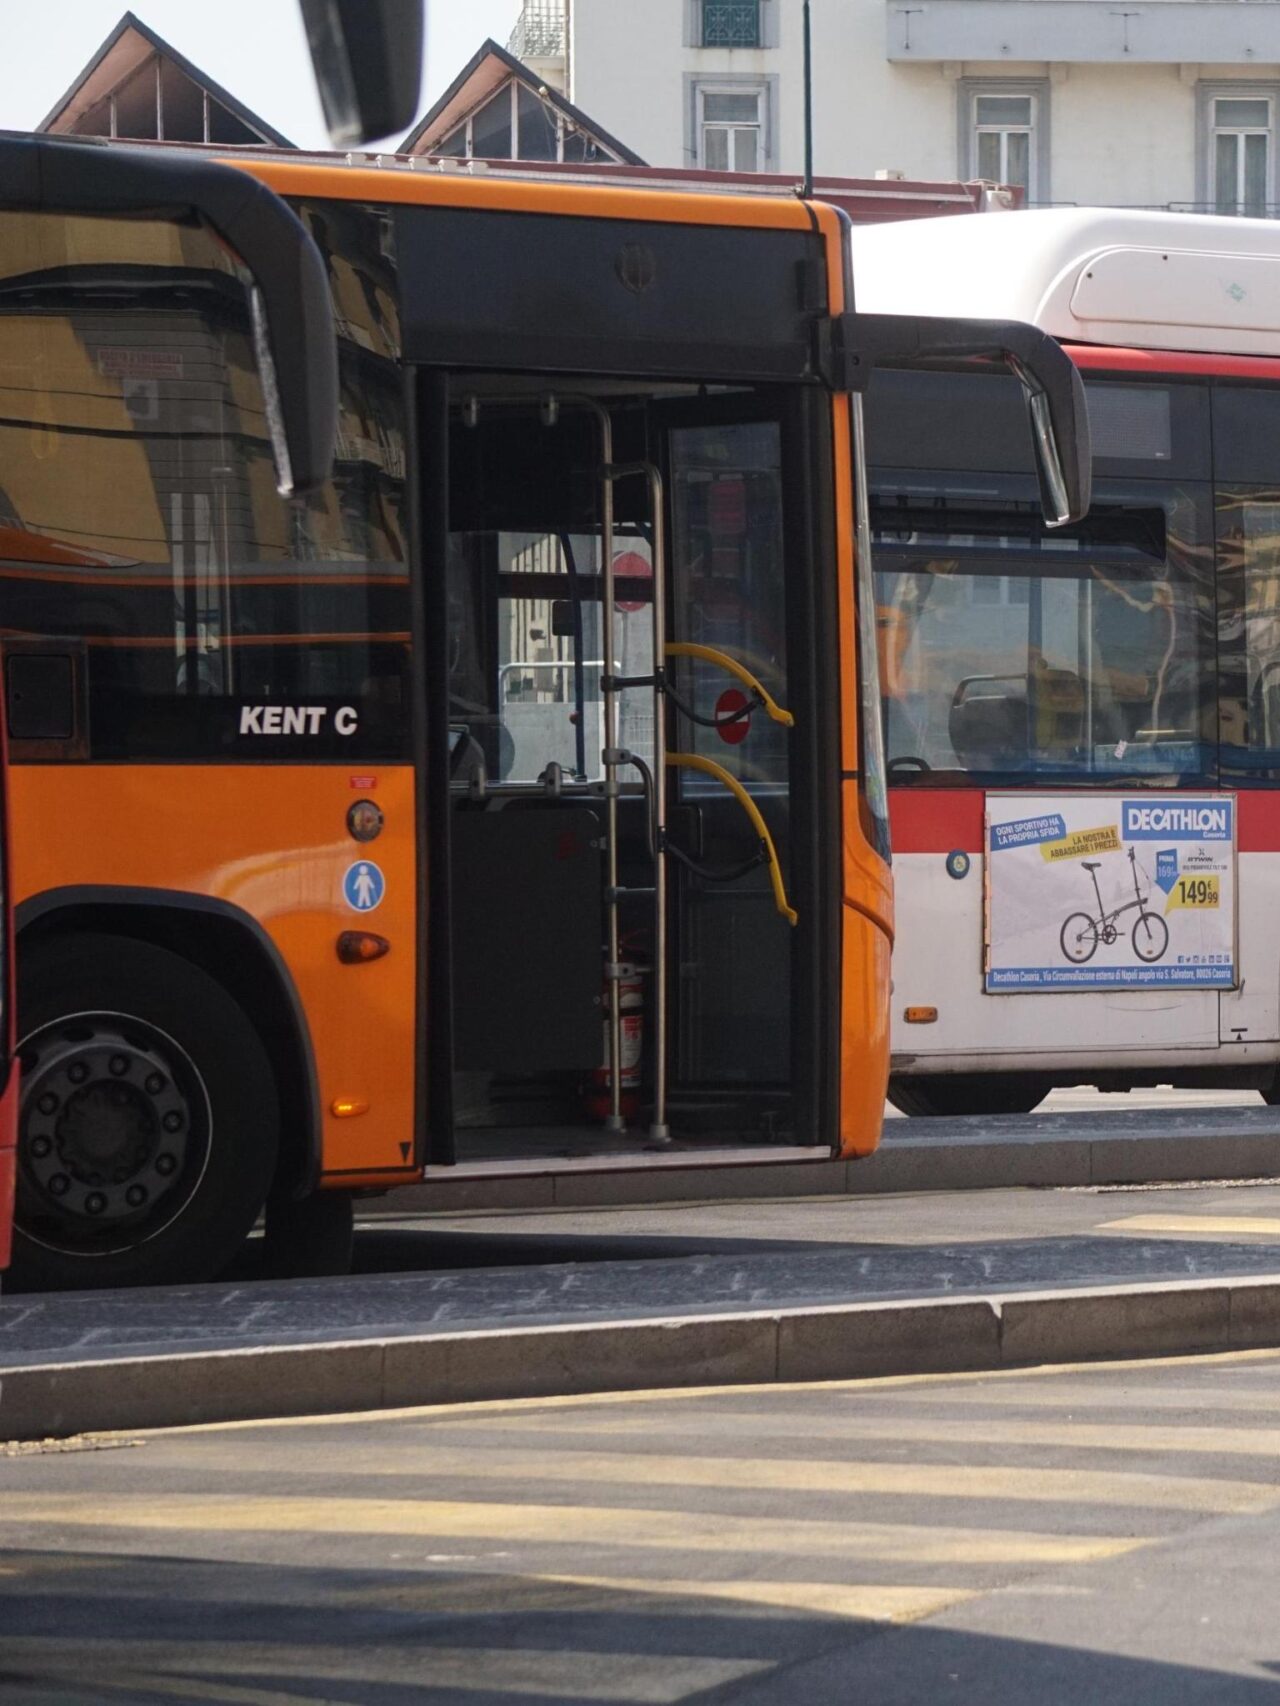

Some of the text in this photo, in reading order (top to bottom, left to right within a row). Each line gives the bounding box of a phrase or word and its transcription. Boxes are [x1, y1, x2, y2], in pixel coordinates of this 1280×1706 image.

[239, 706, 358, 736] KENT C
[996, 817, 1060, 836] OGNI SPORTIVO HA
[1128, 808, 1226, 831] DECATHLON
[998, 827, 1060, 845] LA PROPRIA SFIDA
[1072, 837, 1081, 845] LA
[1082, 832, 1110, 844] NOSTRA
[1050, 845, 1089, 858] ABBASSARE
[1095, 840, 1118, 851] PREZZI
